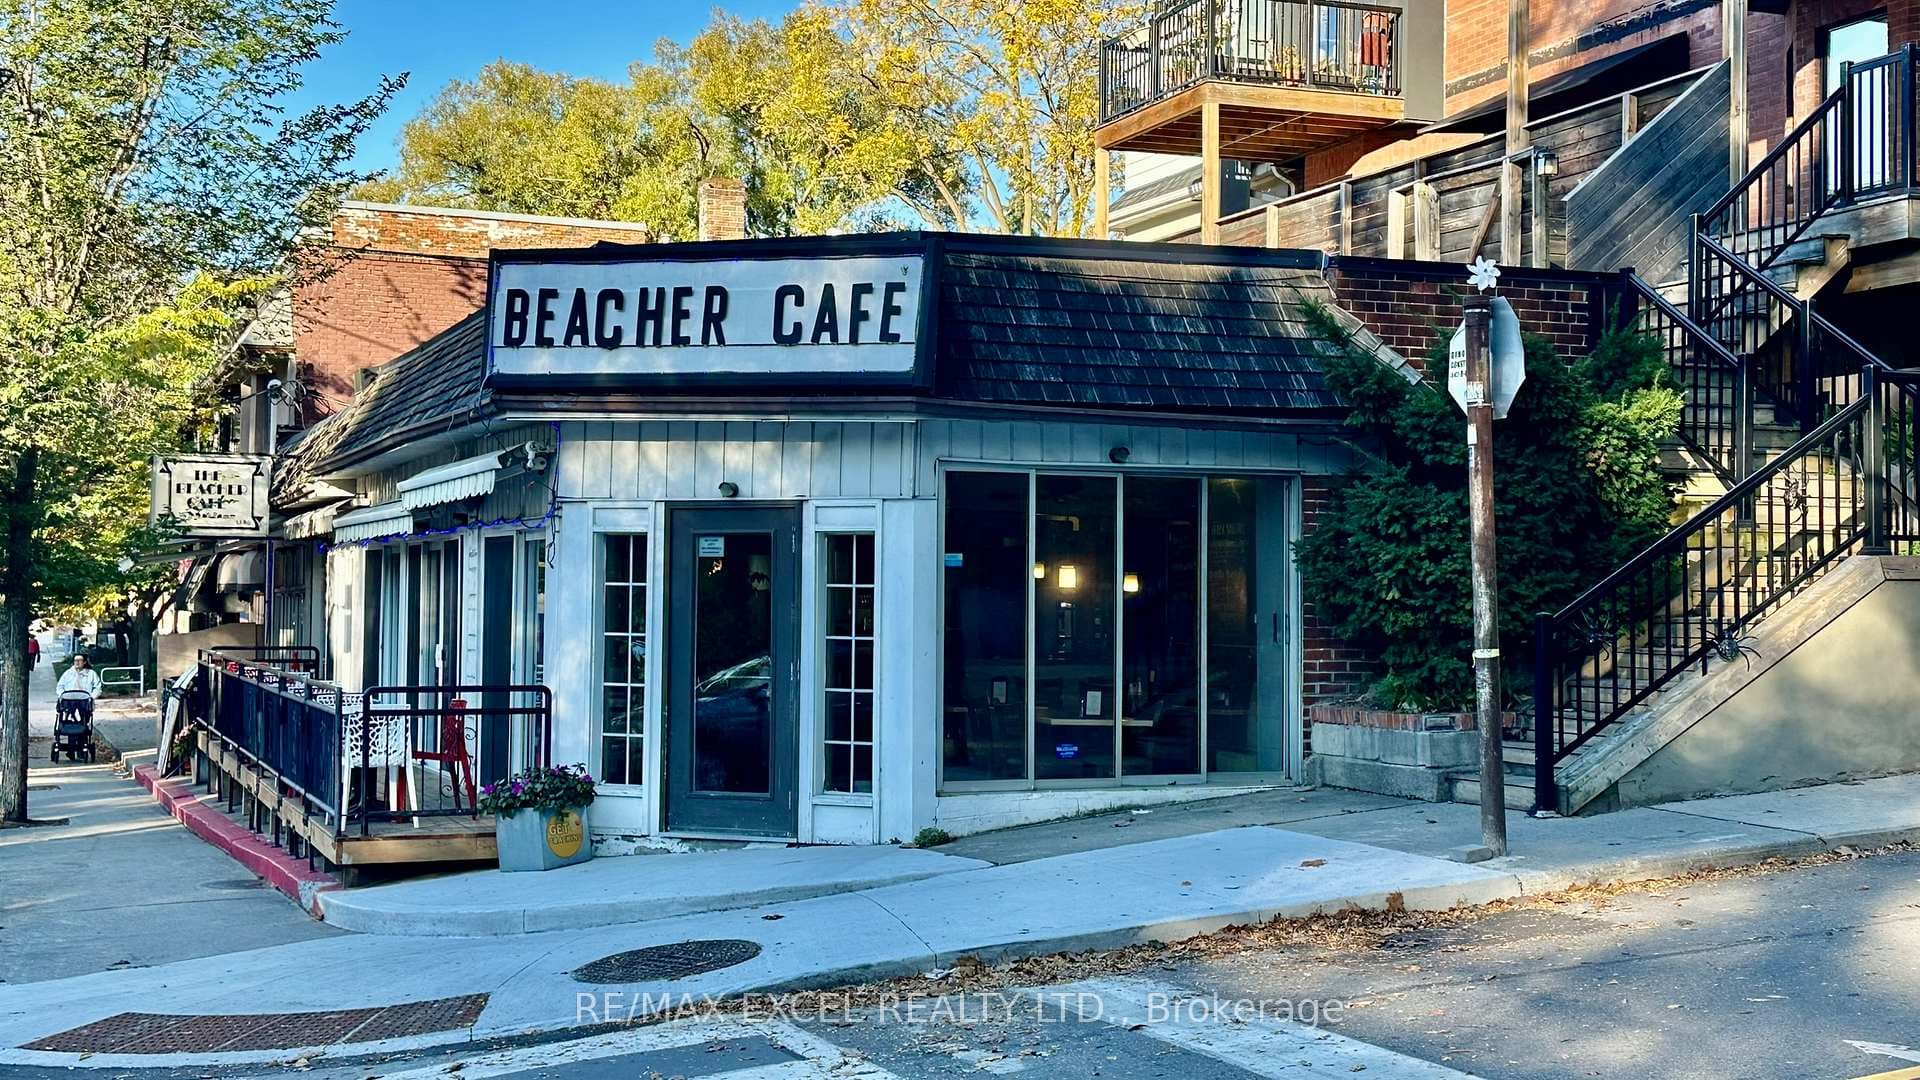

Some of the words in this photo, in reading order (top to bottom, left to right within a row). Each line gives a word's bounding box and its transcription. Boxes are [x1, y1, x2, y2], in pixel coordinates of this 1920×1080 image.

[504, 286, 728, 350] BEACHER
[773, 282, 907, 347] CAFE
[194, 470, 222, 481] THE
[176, 483, 248, 496] BEACHER
[550, 823, 569, 835] GET
